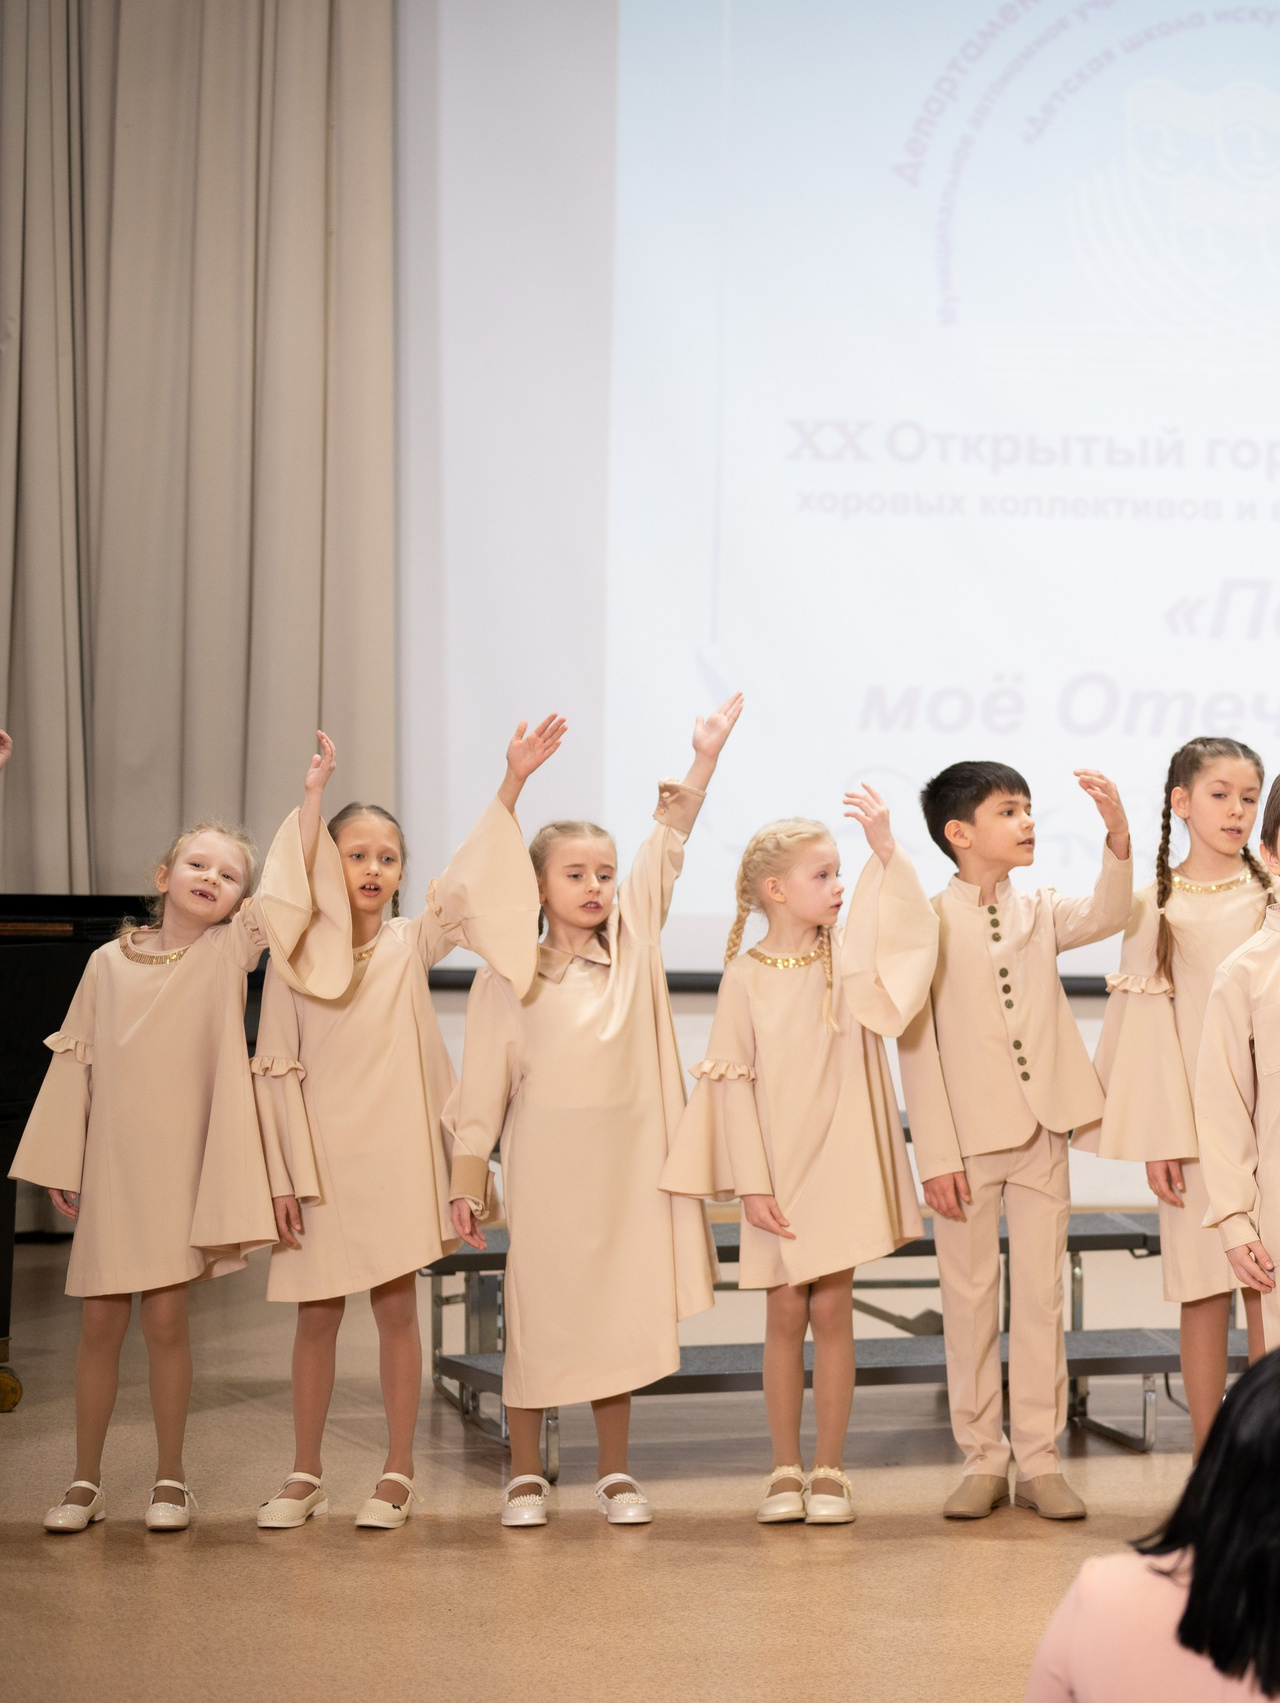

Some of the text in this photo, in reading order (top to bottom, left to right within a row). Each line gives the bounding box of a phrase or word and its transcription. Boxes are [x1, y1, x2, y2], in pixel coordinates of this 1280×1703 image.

[1118, 9, 1206, 54] школа
[884, 419, 1186, 476] Открытый
[796, 490, 967, 521] хоровых
[979, 494, 1225, 522] коллективов
[1237, 500, 1257, 522] и
[857, 671, 1027, 733] моё
